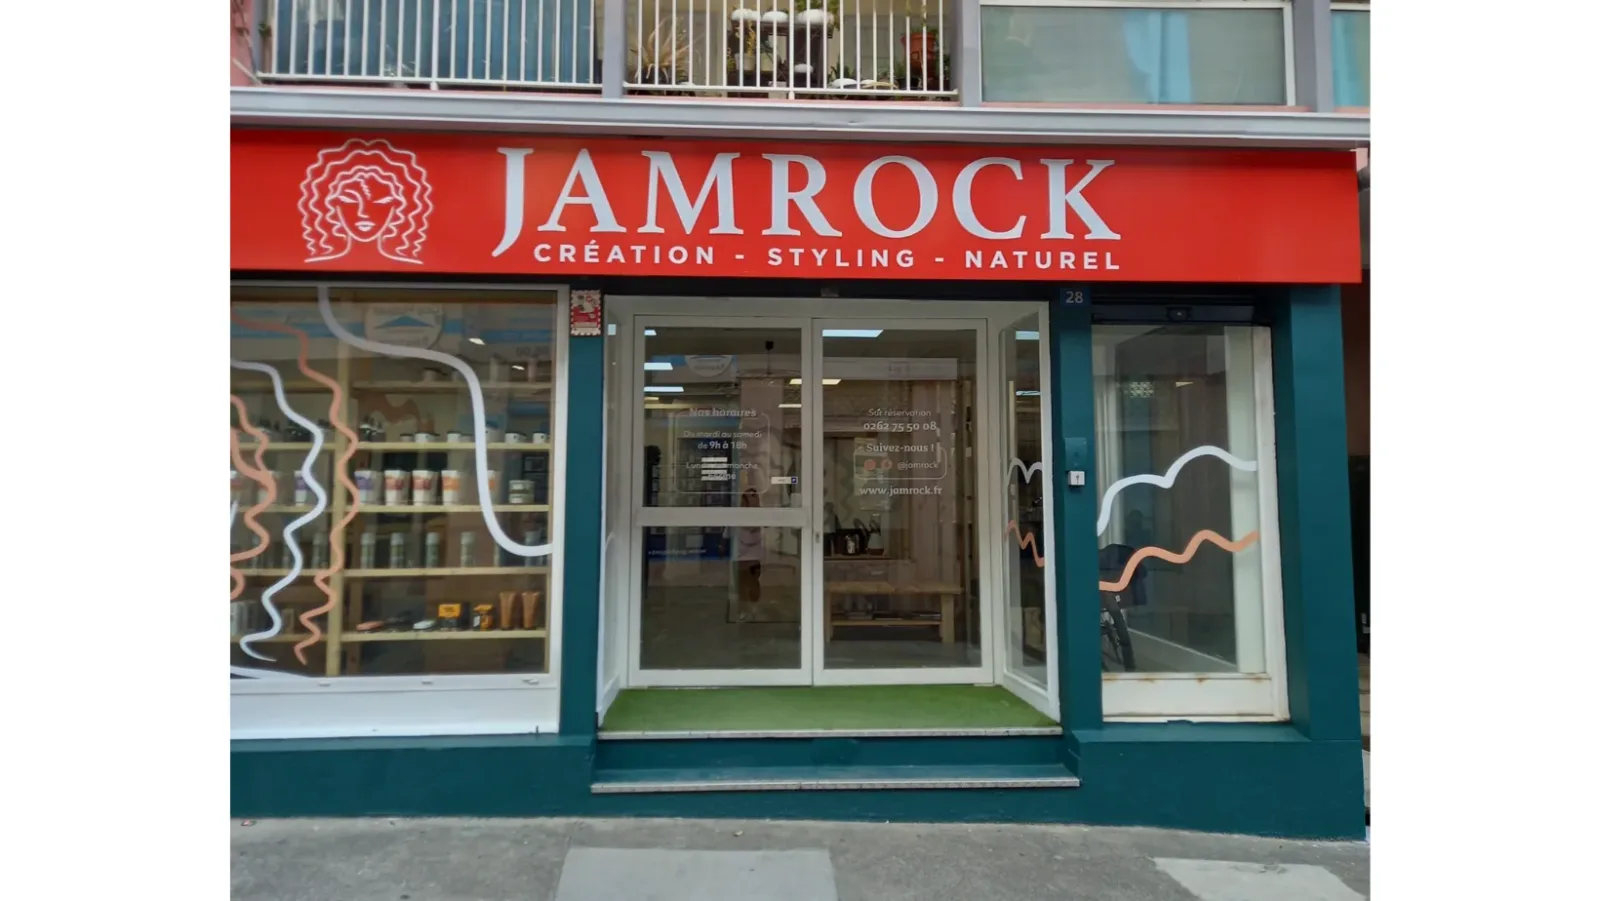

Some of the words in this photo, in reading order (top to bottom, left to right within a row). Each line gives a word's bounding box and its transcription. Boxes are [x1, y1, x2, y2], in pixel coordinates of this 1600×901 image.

[491, 147, 1122, 257] JAMROCK
[533, 240, 714, 265] CRÉATION
[767, 248, 915, 269] STYLING
[964, 250, 1121, 270] NATUREL
[1065, 291, 1083, 304] 28
[689, 407, 711, 417] Nos
[712, 407, 757, 417] horaires
[884, 408, 932, 417] réservation
[863, 421, 889, 431] 0262
[891, 423, 905, 433] 75
[906, 423, 920, 433] 50
[922, 421, 937, 431] 08
[683, 430, 695, 438] Du
[696, 430, 720, 438] mardi
[732, 430, 762, 438] samedi
[709, 441, 721, 449] 9h
[722, 441, 729, 449] à
[731, 441, 748, 449] 18h
[866, 442, 929, 453] Suivez-nous
[897, 460, 939, 471] @jamrock
[860, 485, 943, 496] www.jamrock.fr
